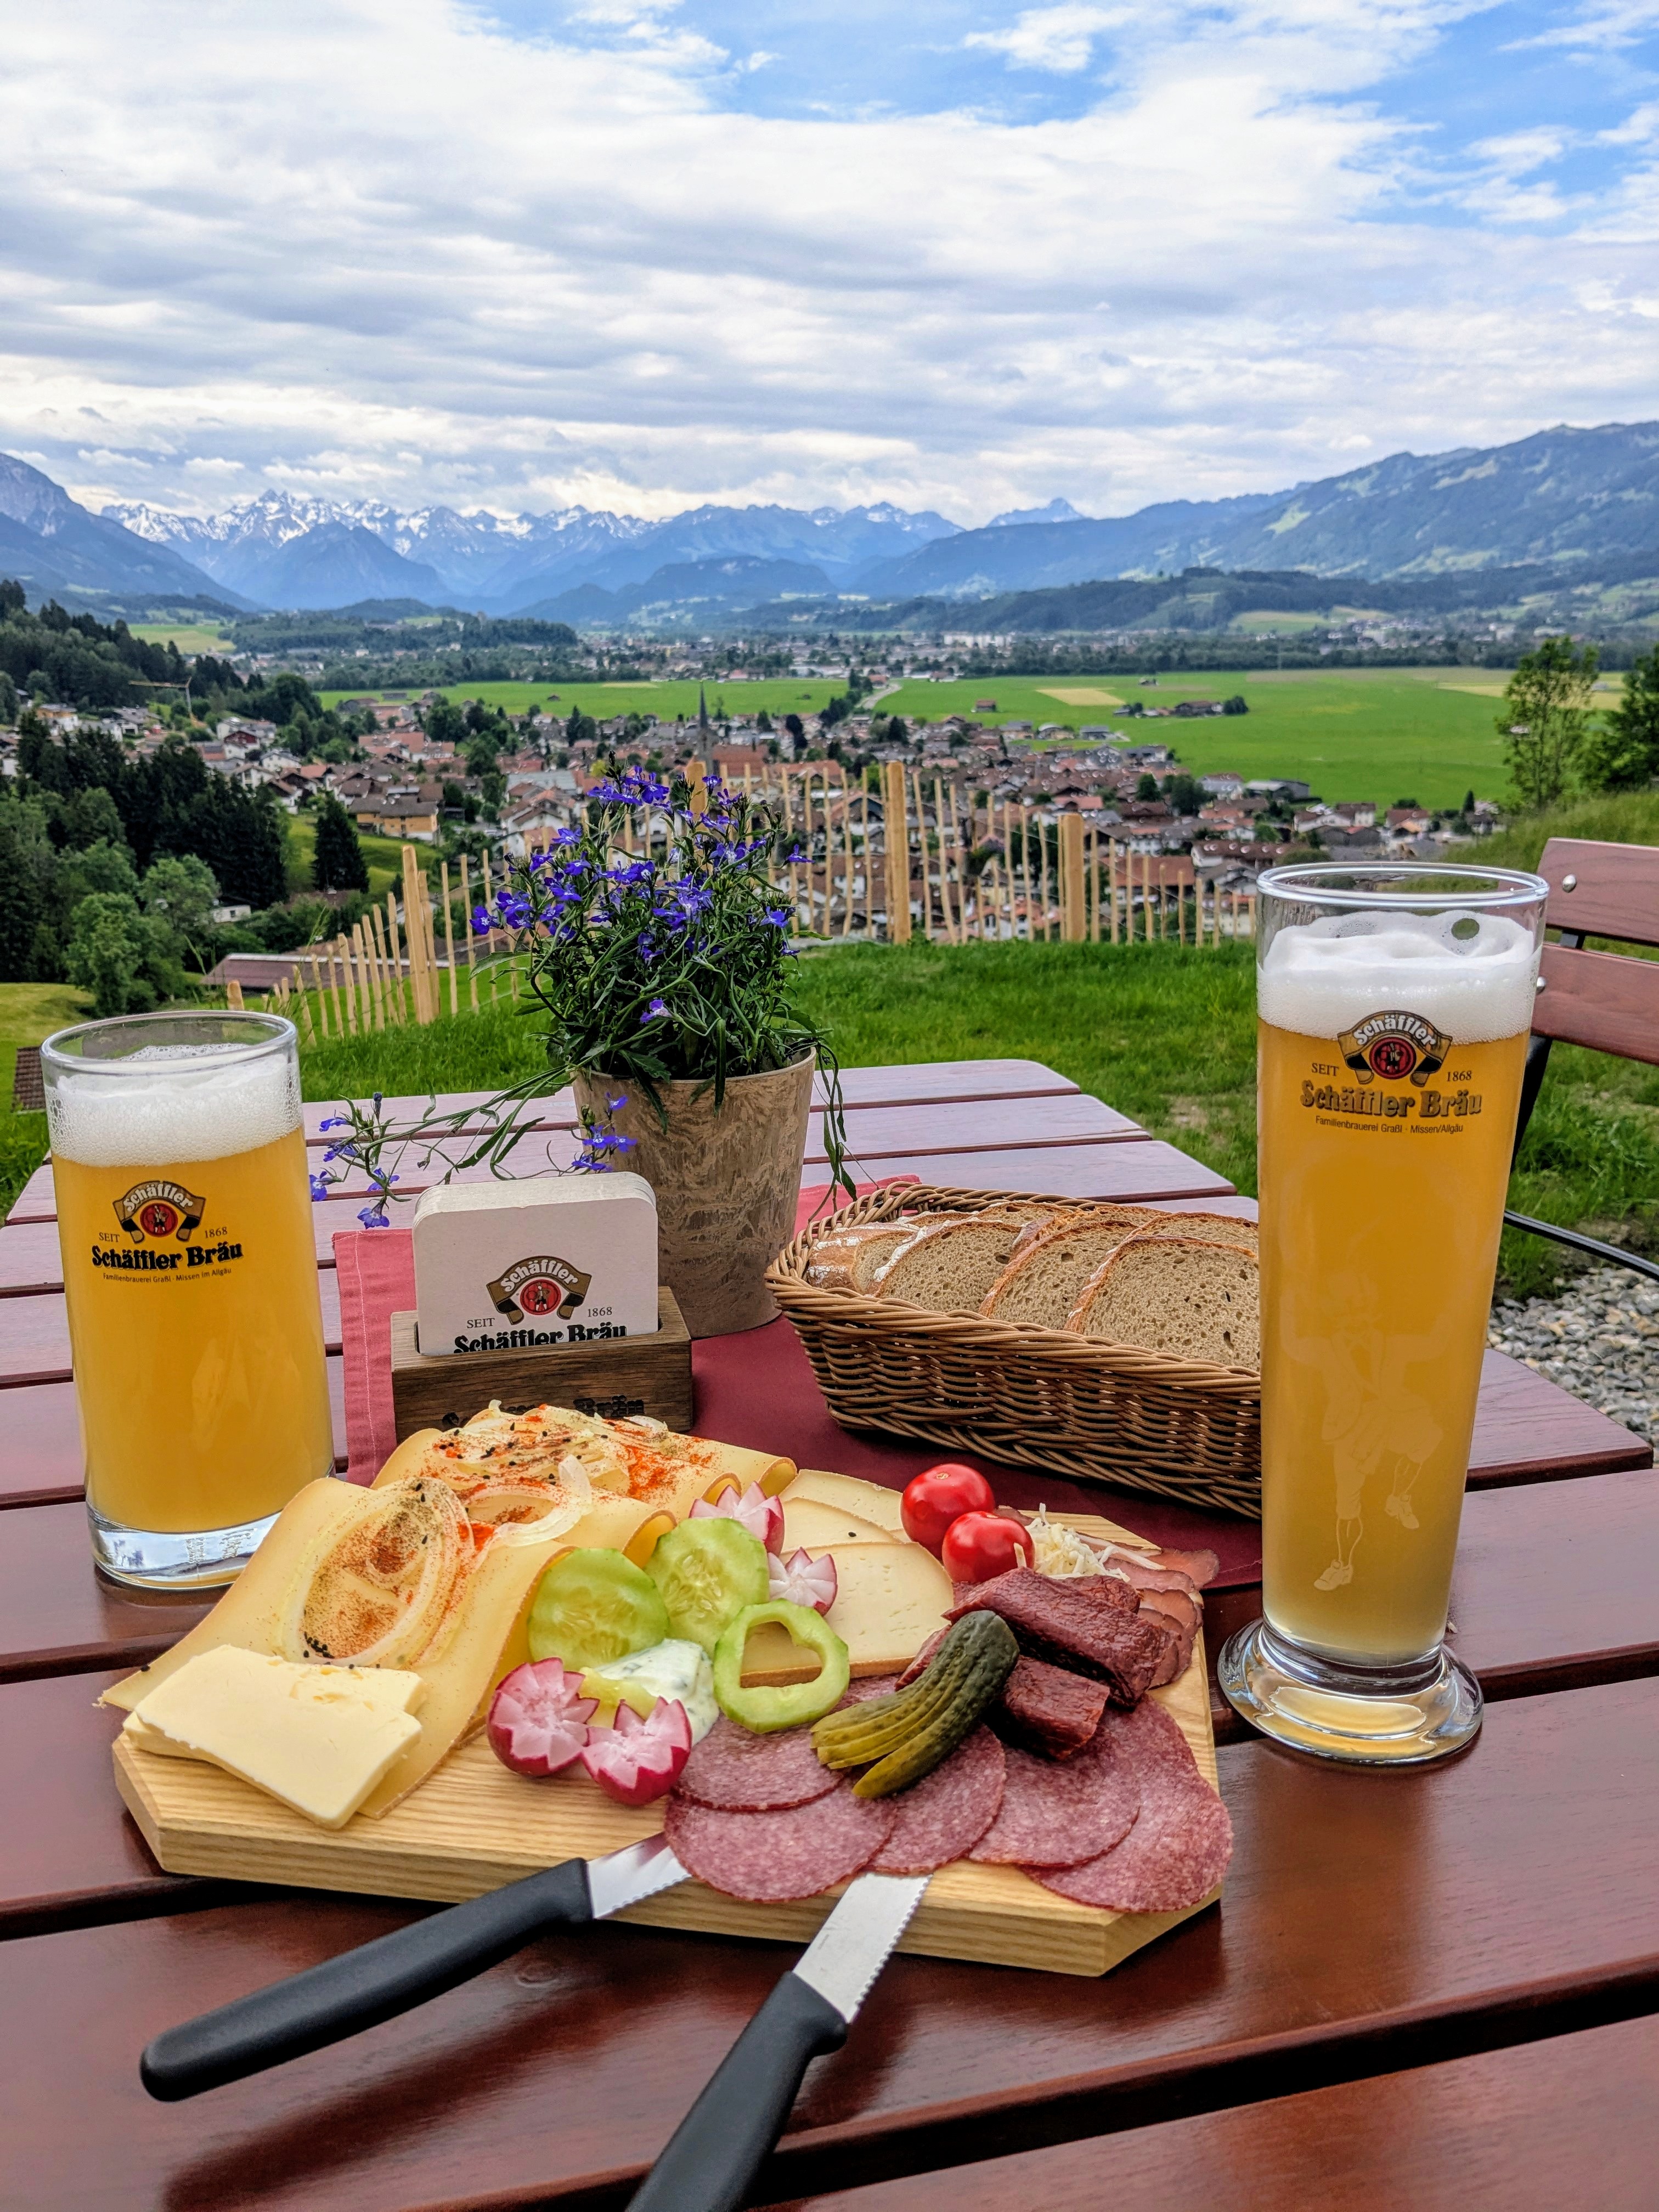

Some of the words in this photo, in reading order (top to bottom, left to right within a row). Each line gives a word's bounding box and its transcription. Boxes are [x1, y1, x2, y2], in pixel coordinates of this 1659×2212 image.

[1353, 1014, 1437, 1046] Schäffler
[1311, 1063, 1339, 1076] SEIT
[1446, 1070, 1472, 1082] 1868
[1300, 1080, 1415, 1118] Schäffler
[1419, 1089, 1482, 1118] Bräu
[1316, 1115, 1378, 1132] Familienbrauerei
[1381, 1124, 1402, 1133] Graßl
[1410, 1124, 1463, 1134] Missen/Allgäu
[123, 1183, 194, 1212] Schäffler
[99, 1232, 120, 1243] SEIT
[205, 1226, 228, 1239] 1868
[92, 1245, 183, 1272] Schäffler
[185, 1241, 244, 1268] Bräu
[103, 1273, 151, 1283] Familienbrauerei
[212, 1268, 232, 1277] Allgäu
[500, 1259, 578, 1292] Schäffler
[466, 1317, 495, 1329] SEIT
[587, 1306, 613, 1318] 1868
[453, 1329, 564, 1353] Schäffler
[567, 1322, 627, 1342] Bräu
